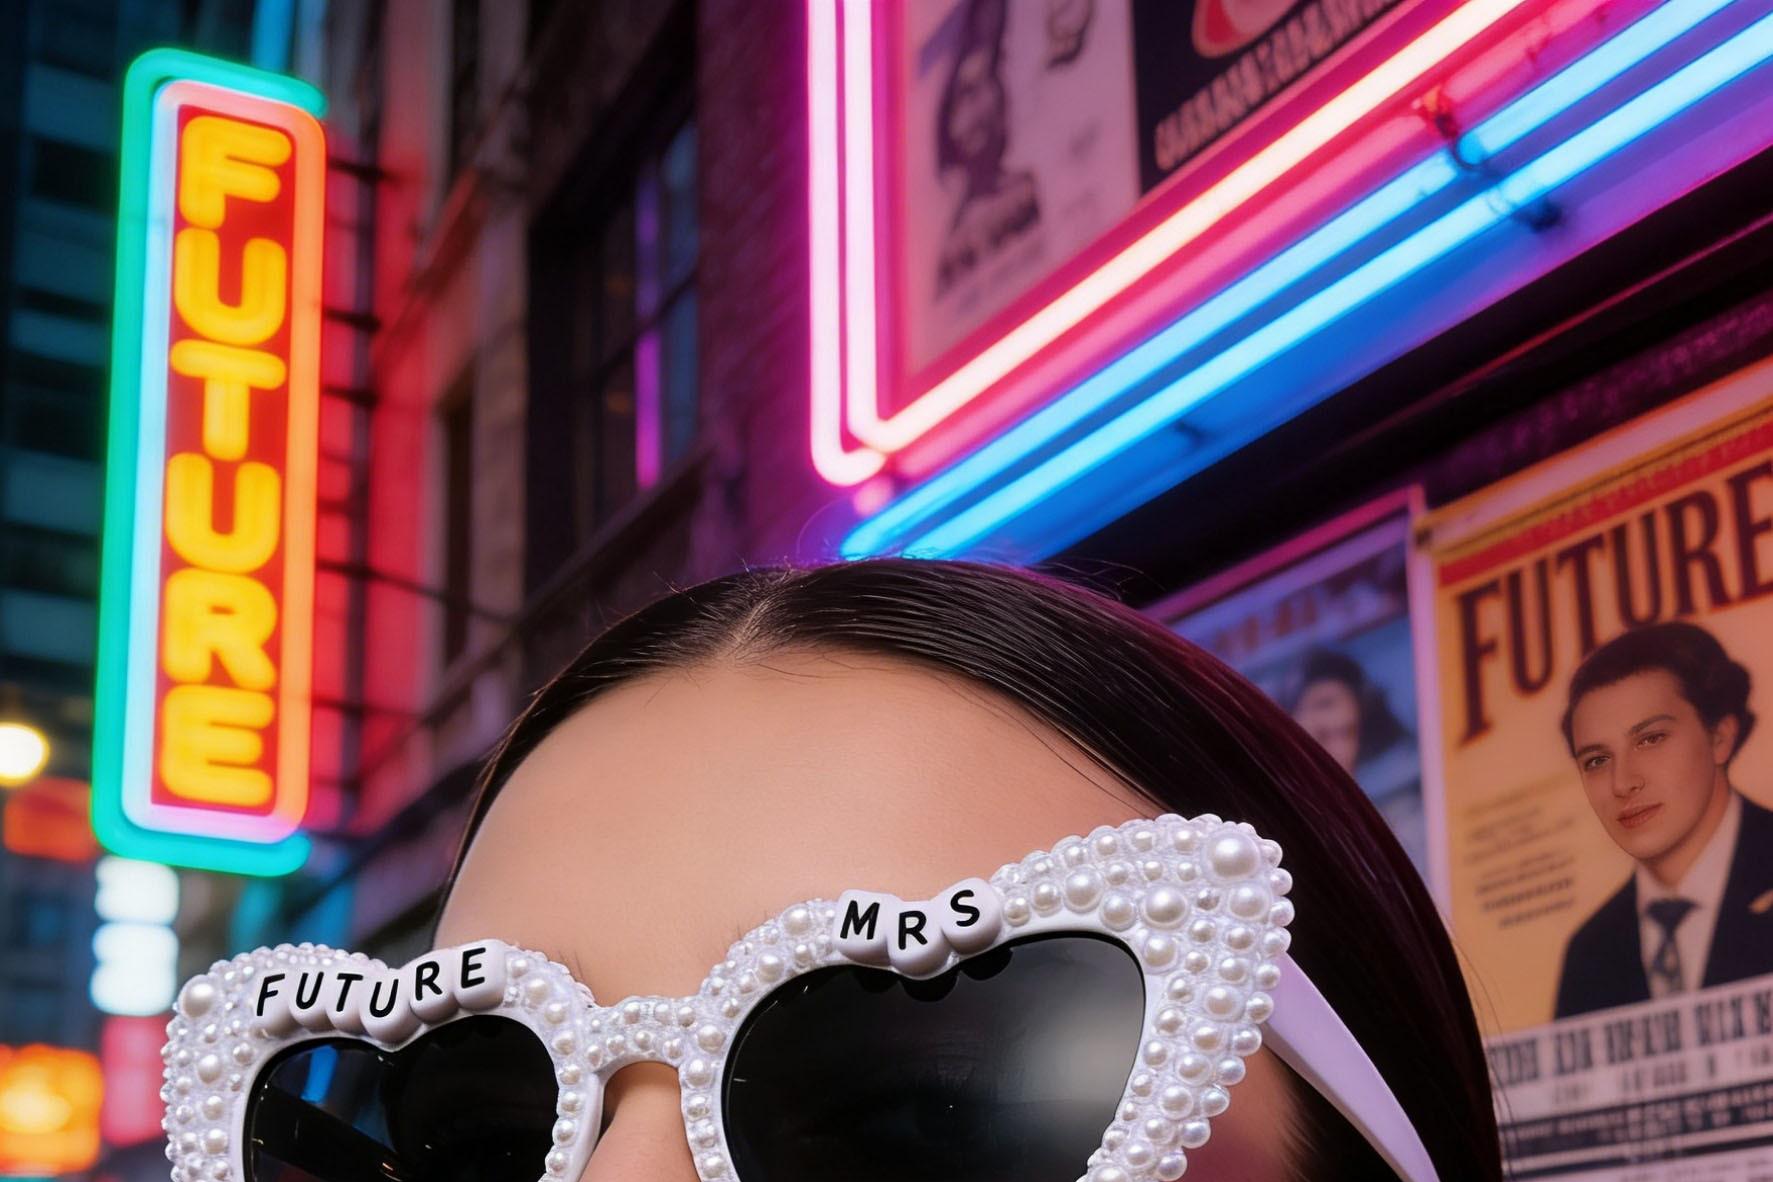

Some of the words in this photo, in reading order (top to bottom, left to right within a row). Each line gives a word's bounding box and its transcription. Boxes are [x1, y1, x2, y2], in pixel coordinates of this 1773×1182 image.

[160, 115, 293, 807] FUTURE
[1456, 458, 1773, 745] FUTURE
[256, 947, 486, 1017] FUTURE
[840, 889, 980, 950] MRS
